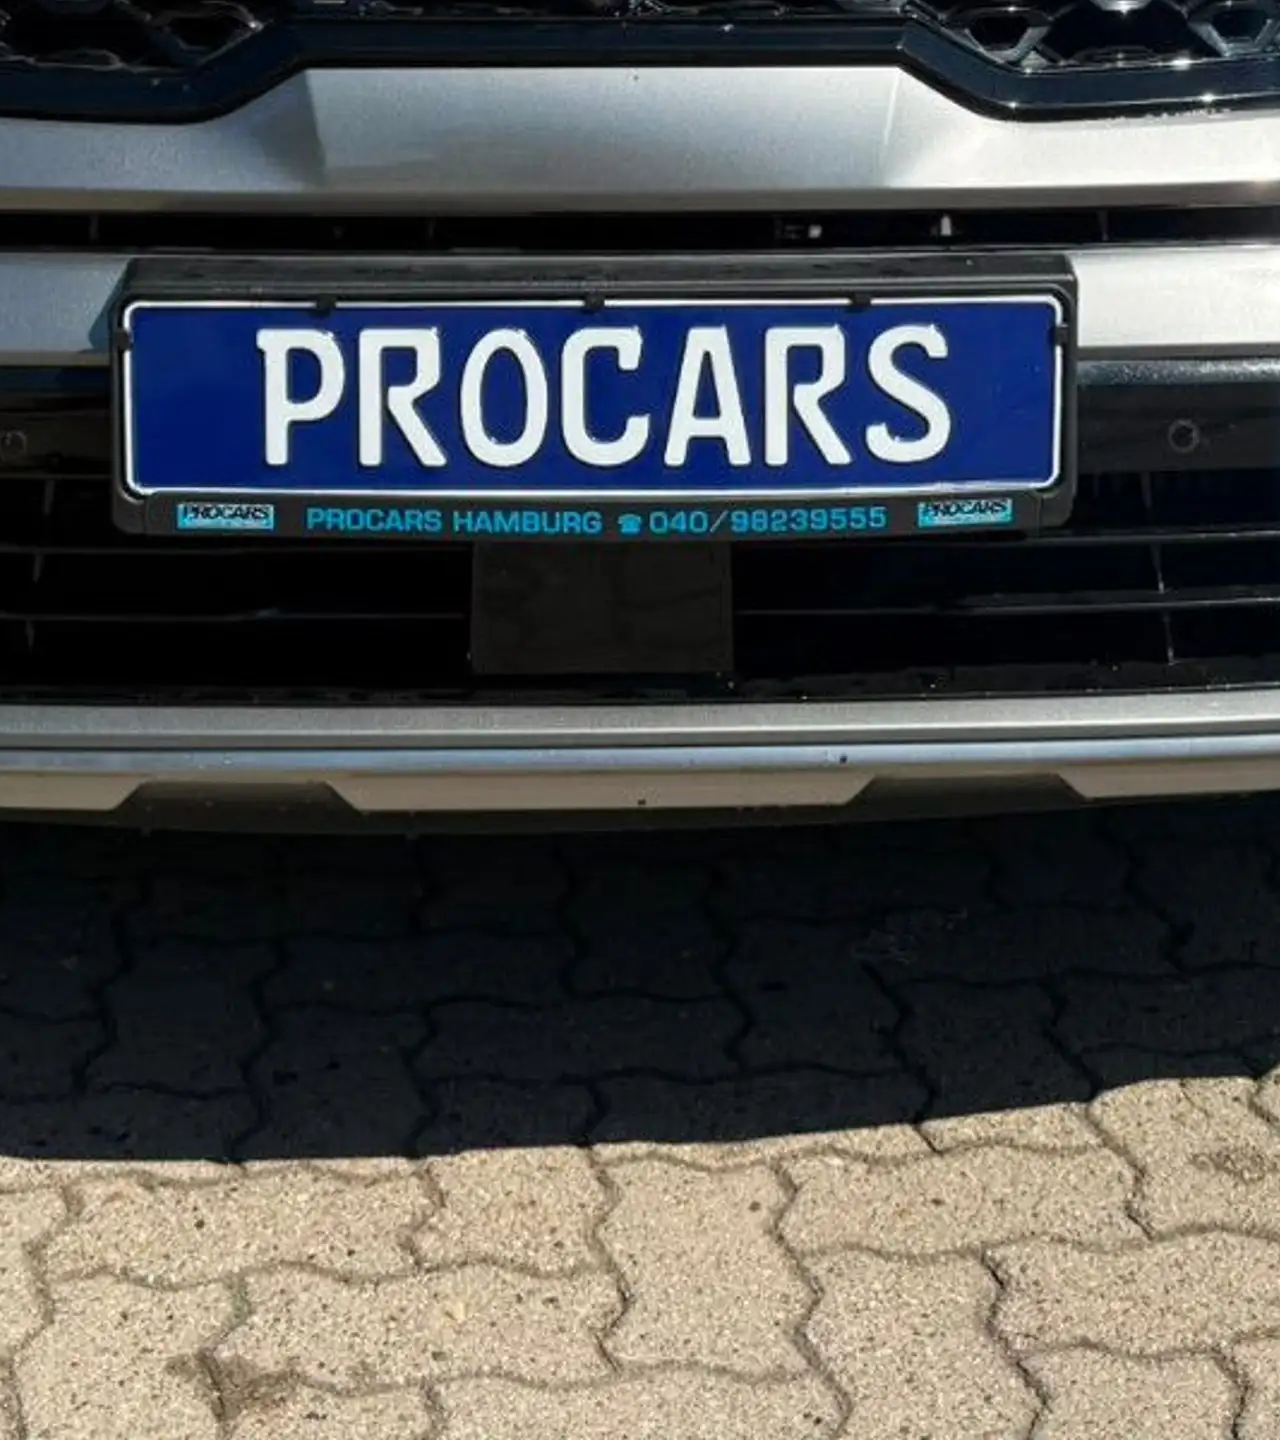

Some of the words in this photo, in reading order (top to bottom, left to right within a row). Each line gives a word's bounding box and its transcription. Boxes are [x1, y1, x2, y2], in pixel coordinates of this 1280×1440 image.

[255, 323, 953, 469] PROCARS
[183, 504, 270, 521] PROCARS
[306, 507, 442, 533] PROCARS
[452, 510, 603, 534] HAMBURG
[648, 506, 887, 534] 040/98239555
